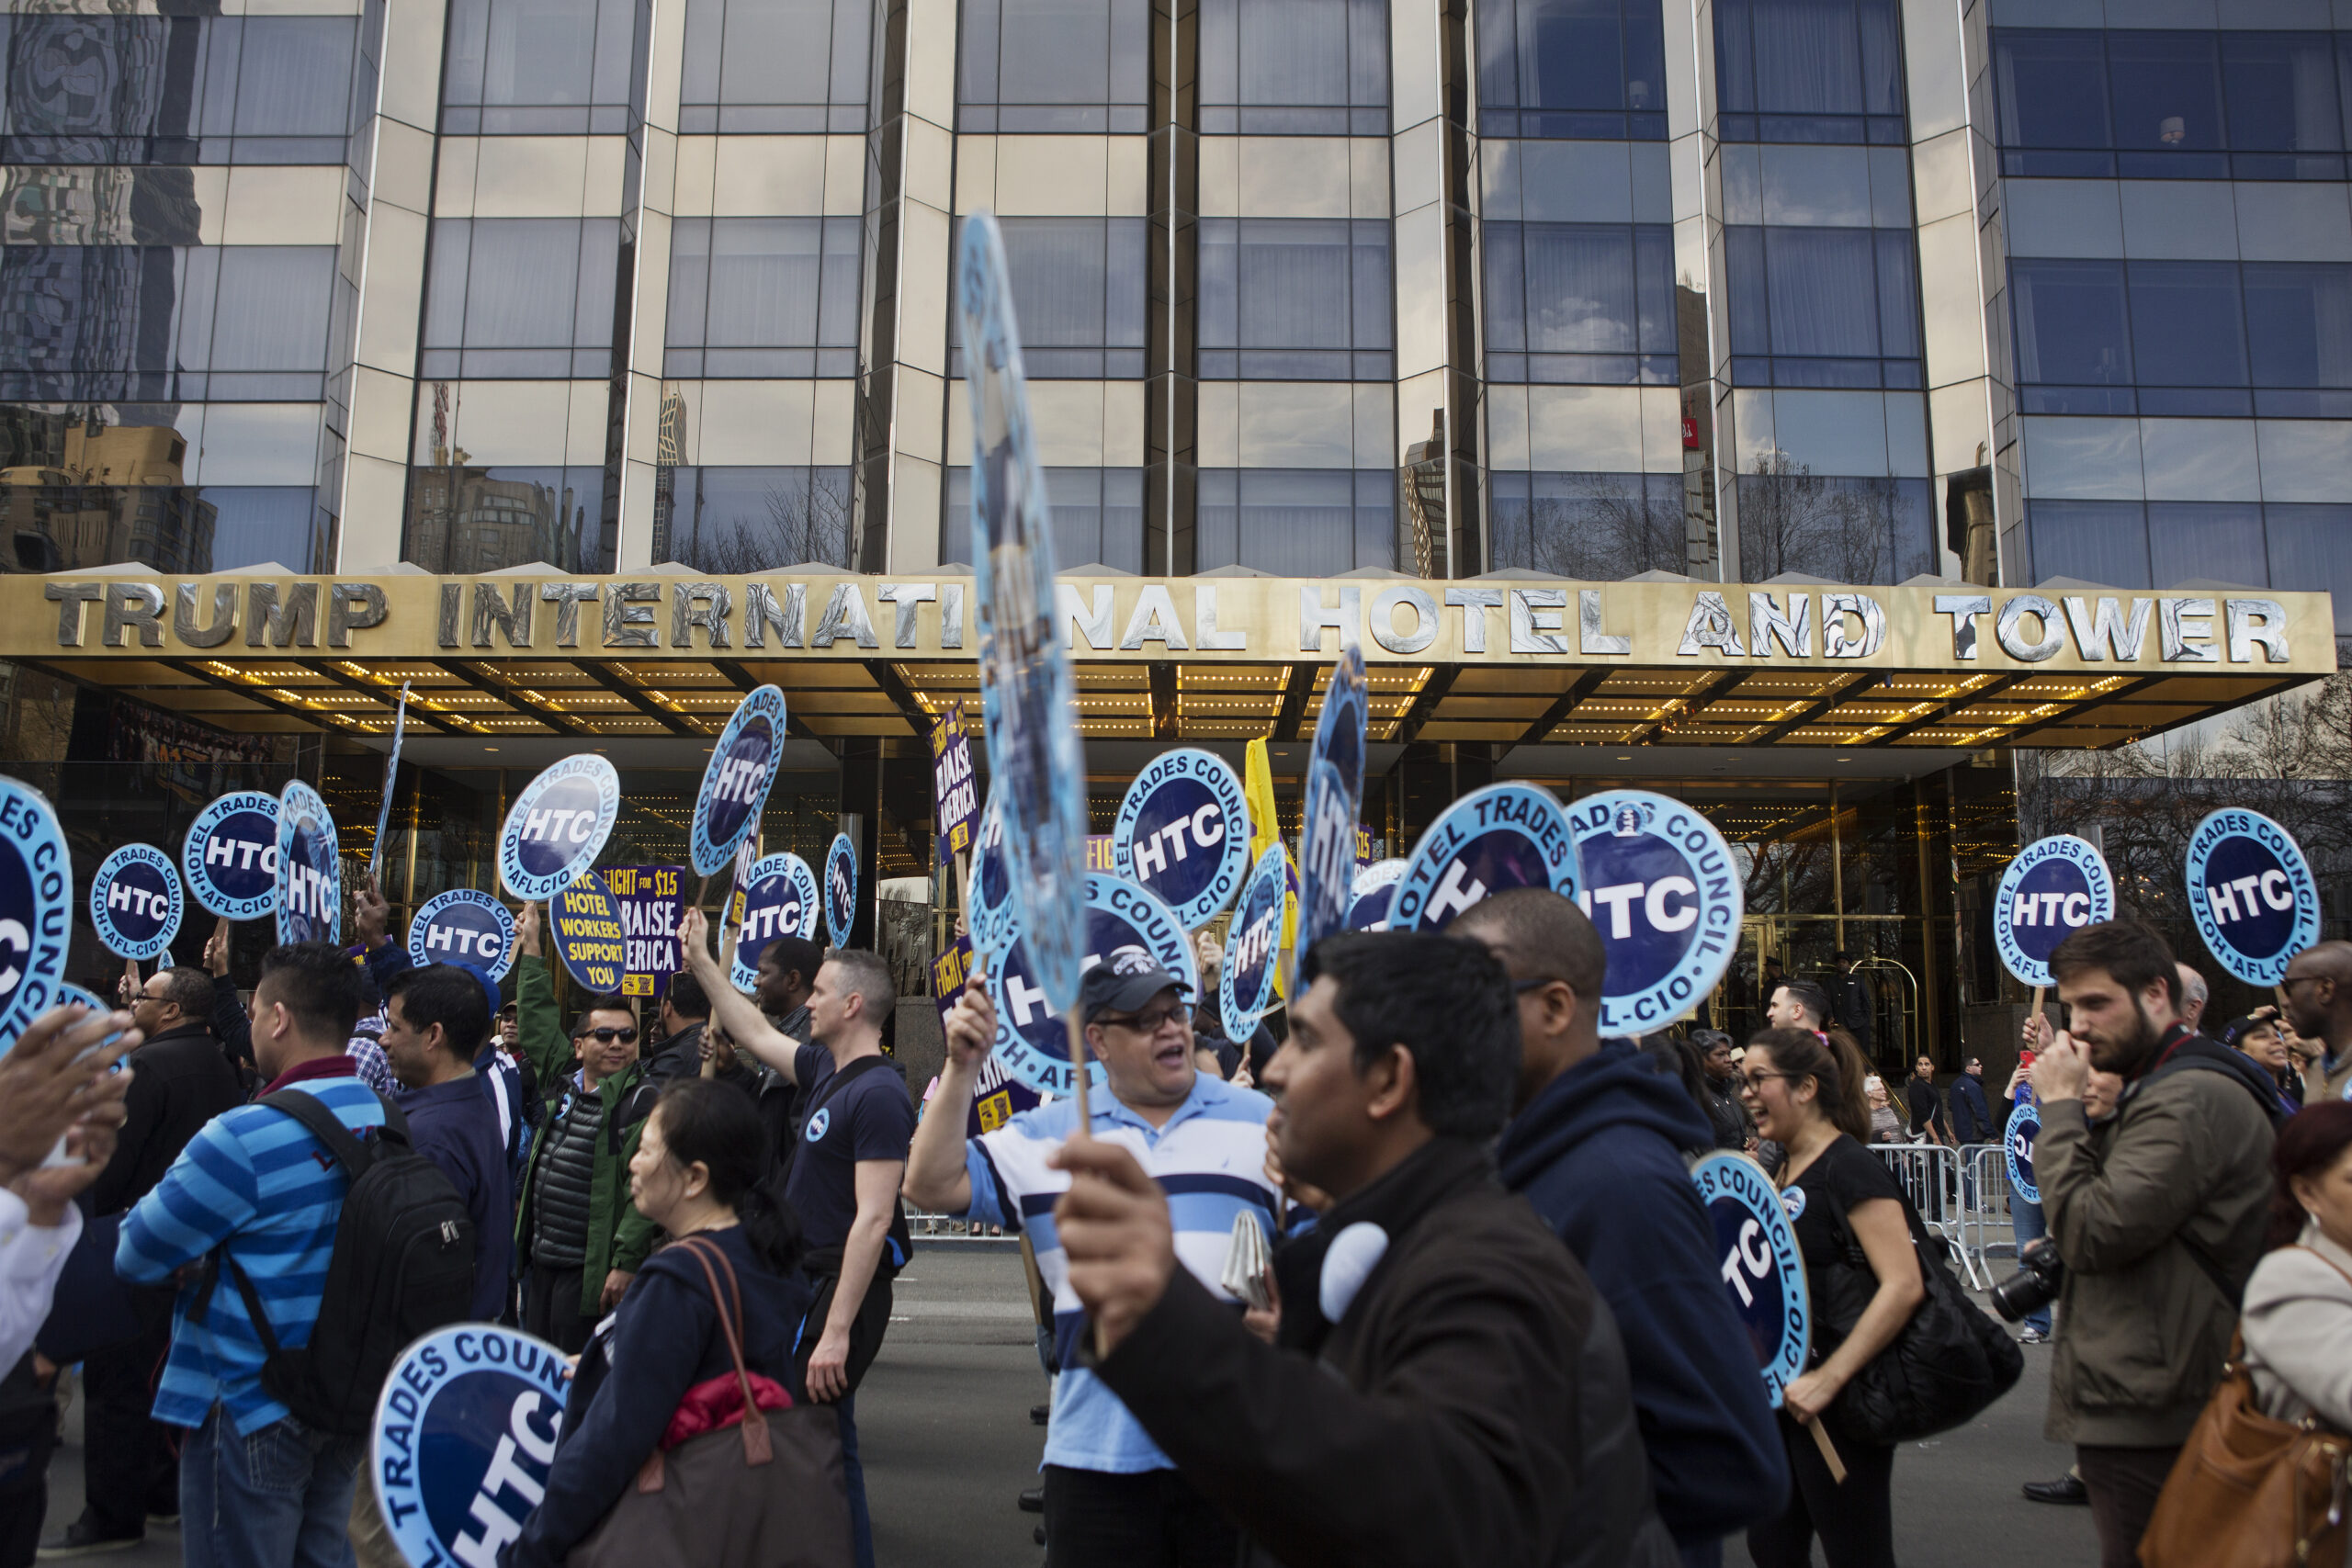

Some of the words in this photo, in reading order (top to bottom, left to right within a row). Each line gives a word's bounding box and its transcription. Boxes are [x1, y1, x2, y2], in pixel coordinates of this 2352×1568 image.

[44, 582, 390, 650] TRUMP
[437, 581, 1247, 651] INTERNATINAL
[1300, 585, 1631, 656] HOTEL
[1677, 590, 1886, 660] AND
[1933, 593, 2291, 664] TOWER
[733, 692, 780, 731] TRADES
[696, 738, 730, 831] HOTEL
[712, 755, 766, 806] HTC
[744, 717, 784, 828] COUNCIL
[284, 790, 323, 830] TRADES
[504, 796, 535, 864] HOTEL
[536, 760, 603, 791] TRADES
[579, 773, 616, 863] COUNCIL
[520, 807, 597, 844] HTC
[940, 778, 977, 838] AMERICA
[1121, 755, 1188, 825] TRADES
[1194, 758, 1243, 860] COUNCIL
[188, 820, 212, 885] HOTEL
[209, 795, 278, 820] TRADES
[695, 837, 738, 869] AFL-CIO
[1133, 802, 1225, 883] HTC
[1393, 823, 1465, 931] OTEL
[1474, 795, 1567, 867] TRADES
[2191, 814, 2250, 866] TRADES
[94, 870, 113, 926] HOTEL
[111, 848, 164, 868] TRADES
[161, 867, 181, 937] COUNCIL
[288, 859, 333, 924] HTC
[508, 869, 571, 895] AFL-CIO
[639, 876, 652, 889] FOR
[654, 869, 678, 898] $15
[751, 858, 789, 883] ADES
[827, 847, 839, 897] HOTEL
[832, 861, 852, 919] HTC
[1666, 814, 1732, 957] COUNCIL
[1998, 882, 2016, 950] HOTEL
[2013, 840, 2081, 875] TRADES
[2206, 869, 2294, 926] HTC
[2256, 822, 2315, 930] COUNCIL
[107, 881, 169, 921] HTC
[202, 889, 273, 914] AFL-CIO
[410, 912, 431, 965] HOTEL
[427, 890, 494, 911] TRADES
[563, 891, 610, 917] HOTEL
[621, 900, 676, 937] RAISE
[736, 900, 801, 944] HTC
[1179, 874, 1231, 926] L-CIO
[2012, 892, 2091, 928] HTC
[2191, 875, 2227, 956] HOTEL
[105, 931, 159, 956] AFL-CIO
[425, 923, 502, 958] HTC
[560, 918, 622, 940] WORKERS
[568, 942, 624, 963] SUPPORT
[627, 939, 676, 972] ERICA
[1234, 905, 1275, 980] HTC
[586, 966, 615, 986] YOU
[933, 946, 964, 999] FIGHT
[1222, 927, 1240, 1012] HOTEL
[2010, 955, 2046, 979] AFL-
[1601, 976, 1692, 1027] L-CIO
[2007, 1118, 2018, 1178] COUNCIL
[1719, 1165, 1798, 1285] COUNCIL
[1720, 1217, 1772, 1309] TC
[1764, 1307, 1804, 1402] FL-CIO
[384, 1345, 448, 1530] TRADES
[454, 1333, 570, 1393] COUN
[451, 1390, 563, 1568] HTC
